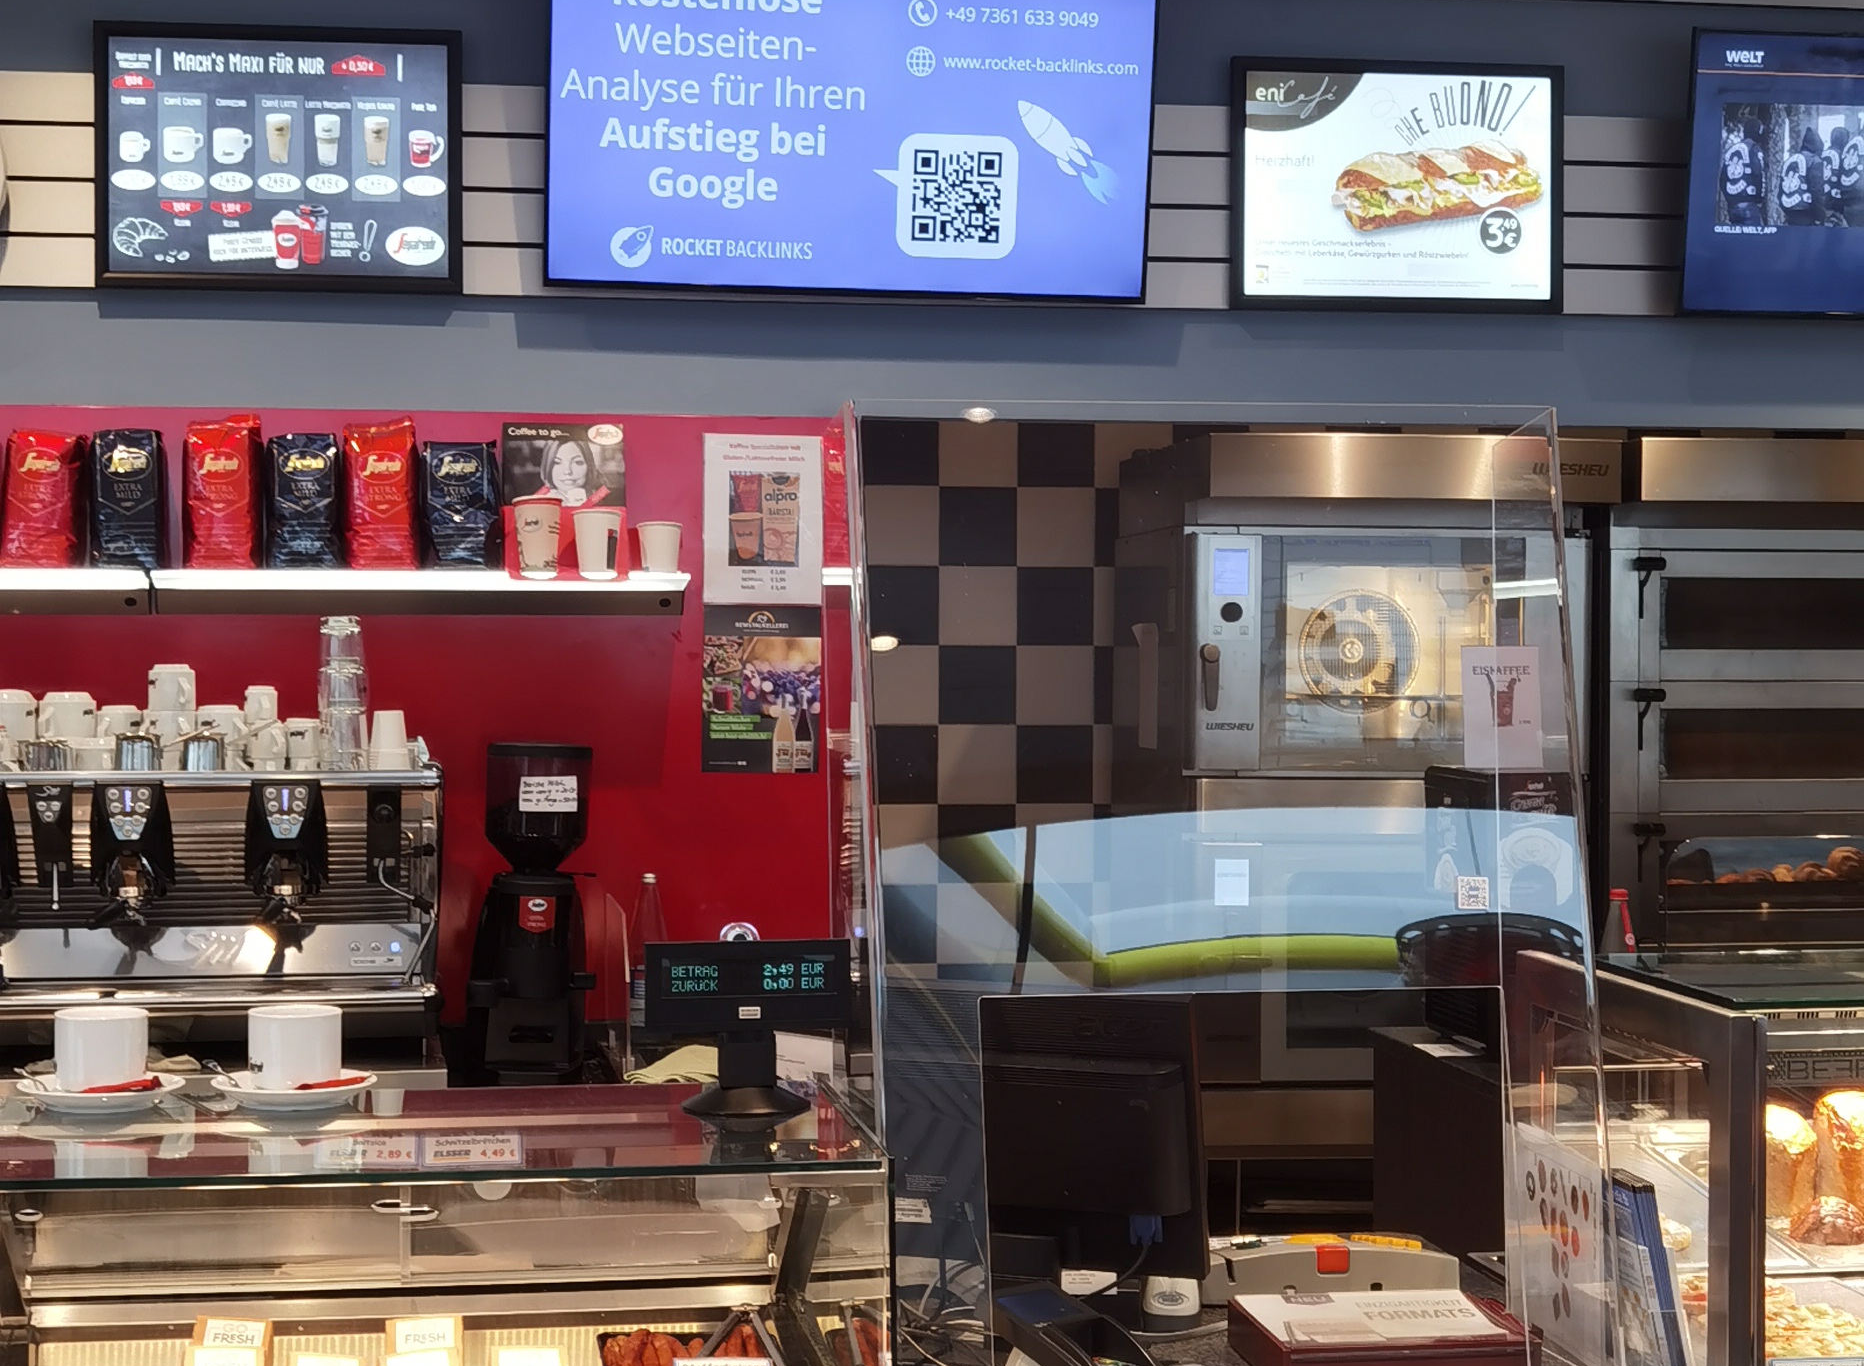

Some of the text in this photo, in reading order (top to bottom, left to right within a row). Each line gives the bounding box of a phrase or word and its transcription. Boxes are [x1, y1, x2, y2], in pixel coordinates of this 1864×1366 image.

[945, 6, 1099, 28] +49 7361 633 9049
[615, 21, 817, 61] Webseiten-
[229, 53, 264, 74] MAXI
[269, 52, 294, 75] FÜR
[298, 56, 325, 75] NUR
[943, 54, 1139, 76] www.rocket-backlinks.com
[560, 68, 867, 110] Analyse für Ihren
[1255, 82, 1285, 102] eni
[1394, 79, 1536, 147] CHE BUONO!
[599, 117, 827, 162] Aufstieg bei
[1255, 153, 1315, 167] Herzhaft!
[648, 167, 778, 208] Google
[1504, 233, 1517, 247] €
[661, 237, 813, 260] ROCKET BACKLINKS
[508, 427, 537, 436] Coffee
[538, 428, 549, 436] to
[1532, 462, 1610, 476] WESHEU
[764, 492, 798, 504] alpro
[671, 965, 718, 978] BETRAG
[801, 963, 825, 975] EUR
[801, 977, 825, 989] EUR
[405, 1150, 412, 1159] €
[509, 1149, 516, 1158] €
[1362, 1308, 1477, 1321] FORMATS
[223, 1323, 248, 1333] GO
[212, 1333, 255, 1345] FRESH
[405, 1333, 446, 1344] FRESH
